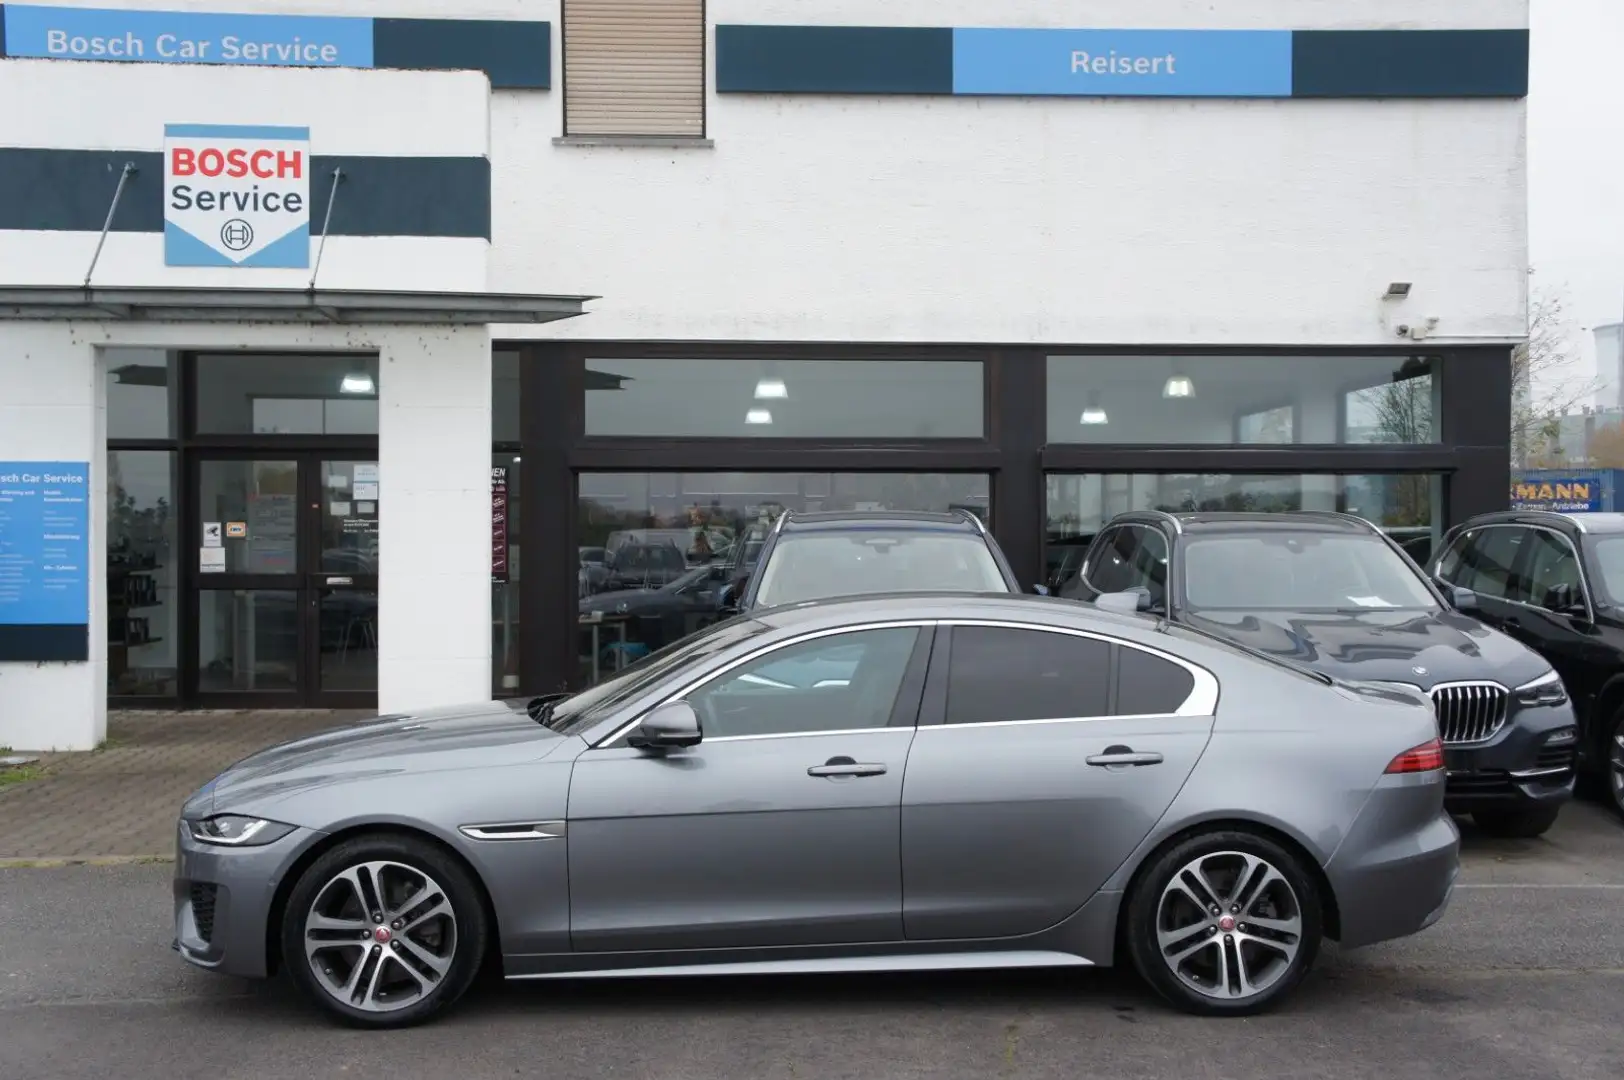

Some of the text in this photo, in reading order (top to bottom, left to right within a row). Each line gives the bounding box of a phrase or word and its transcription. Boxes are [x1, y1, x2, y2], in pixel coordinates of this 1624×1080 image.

[47, 29, 338, 62] Bosch Car Service
[1071, 50, 1176, 74] Reisert
[172, 147, 302, 179] BOSCH
[171, 184, 303, 213] Service
[22, 473, 40, 483] Car
[43, 473, 83, 484] Service
